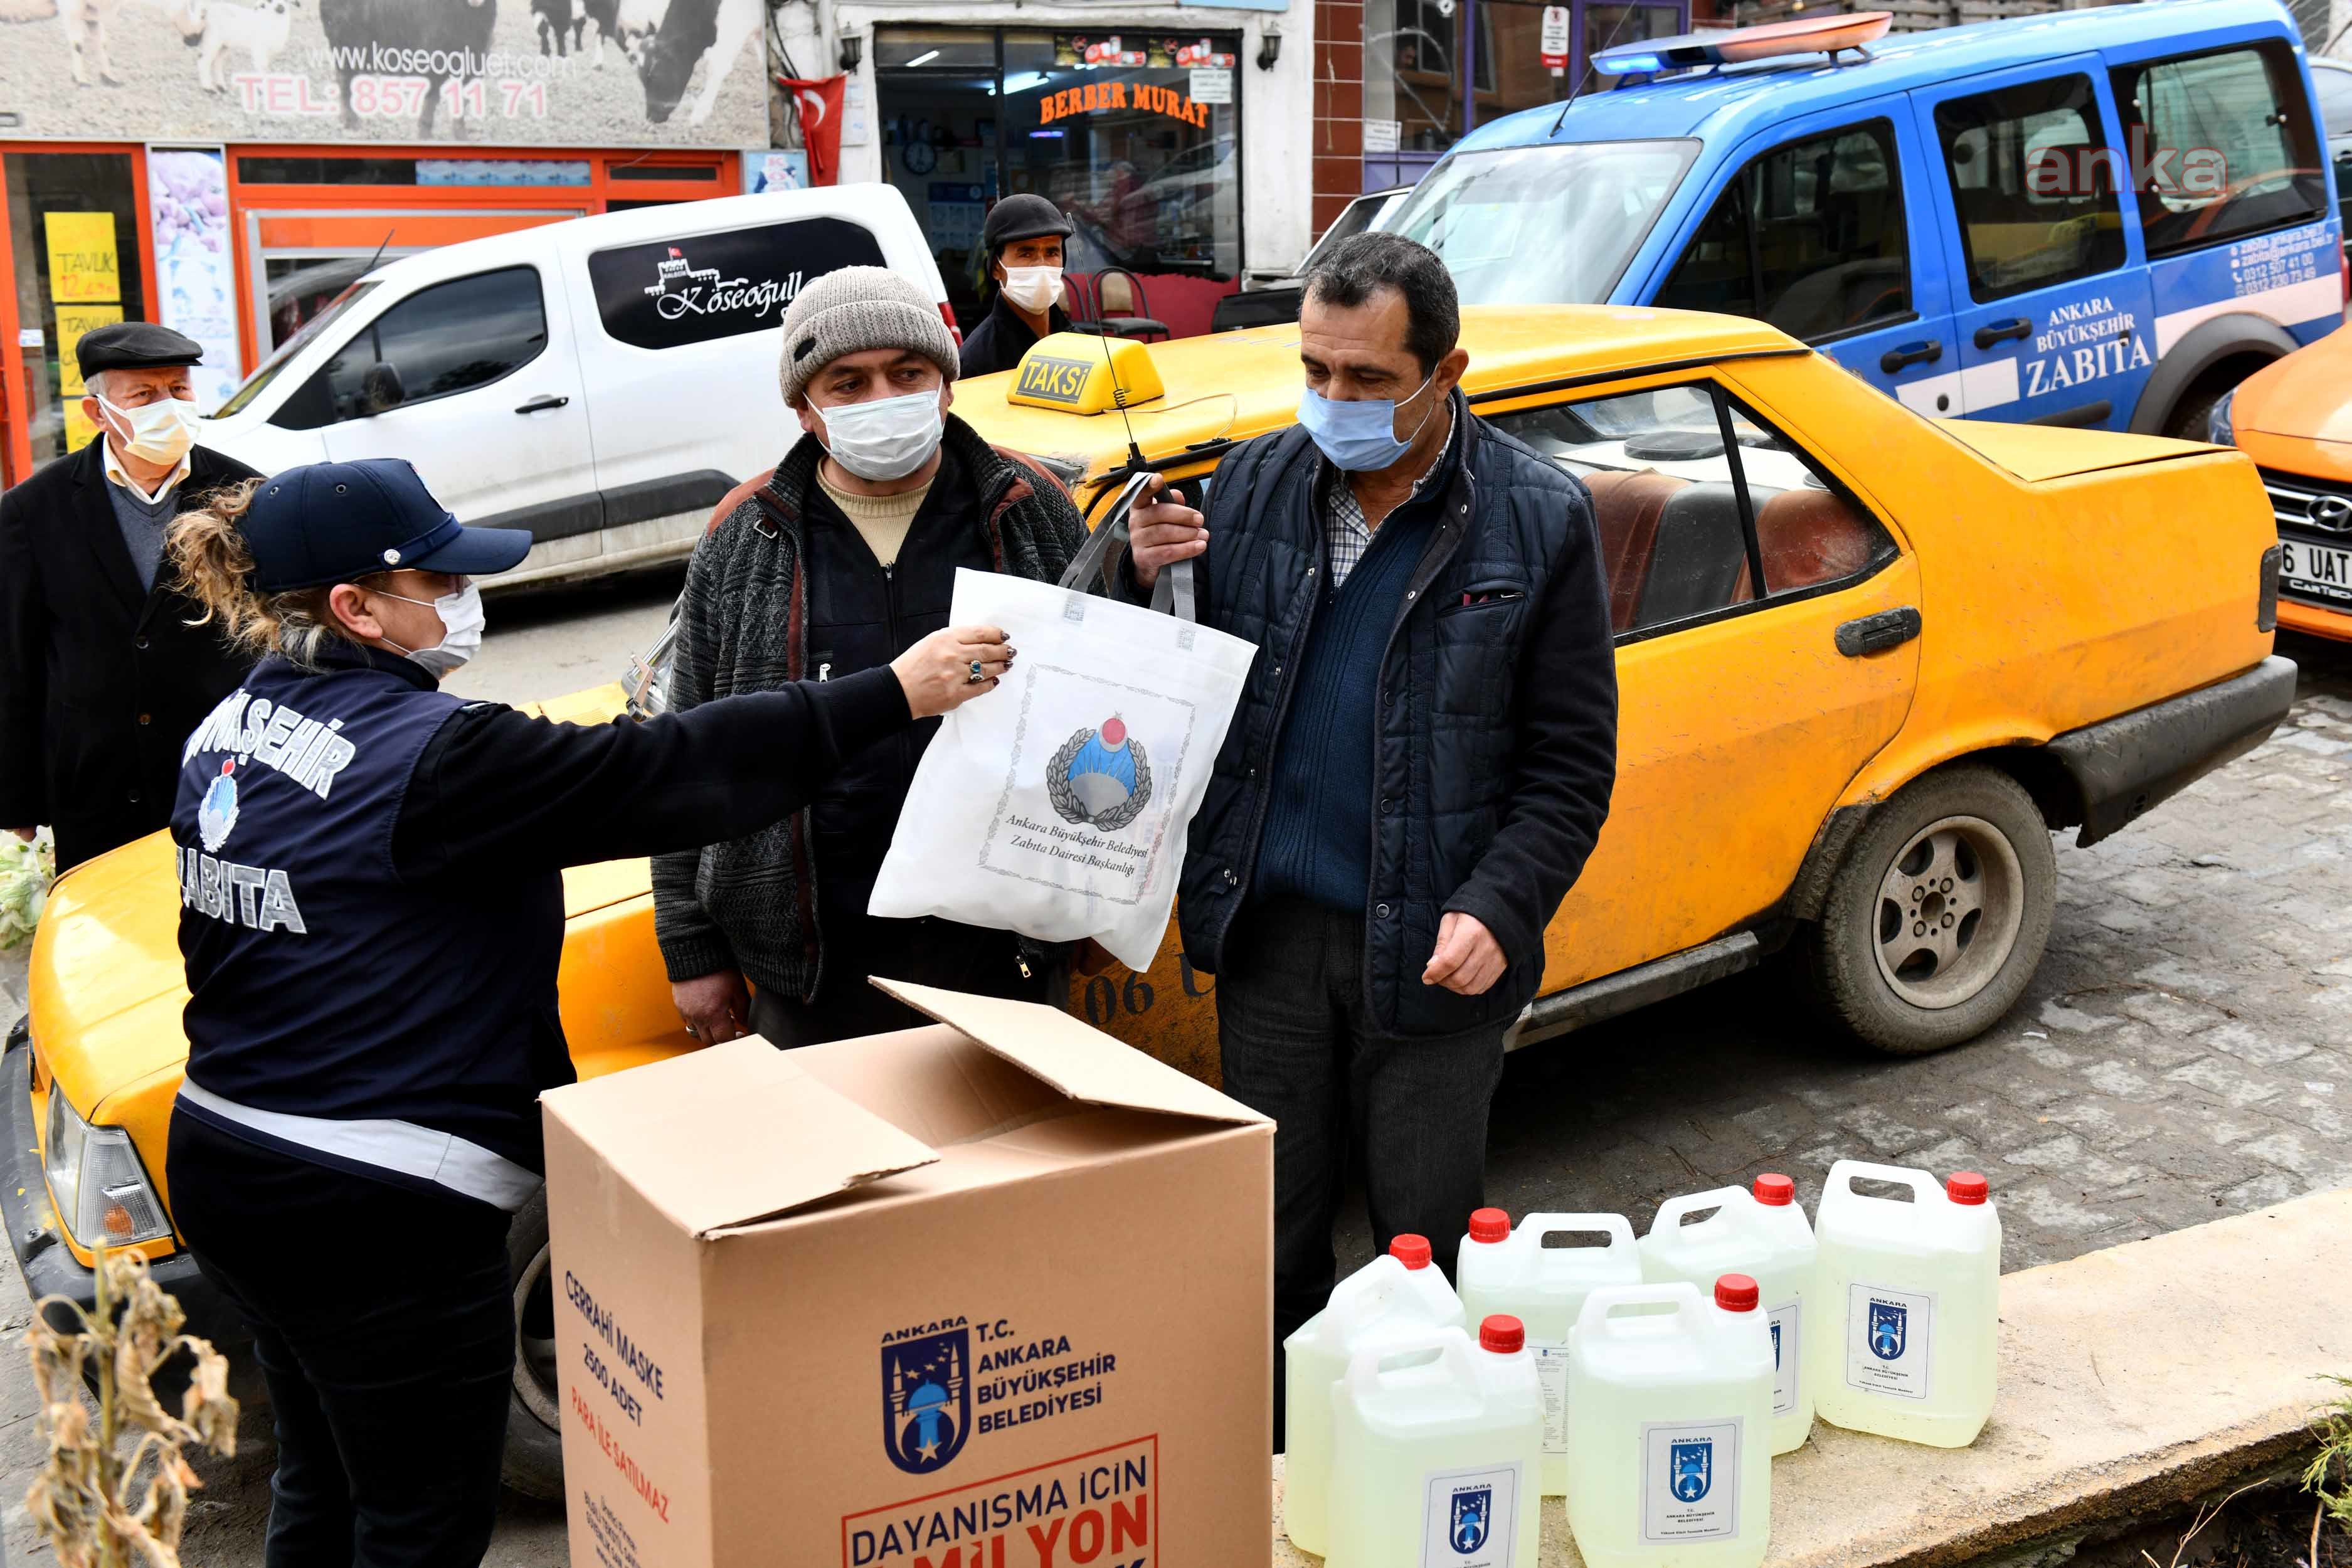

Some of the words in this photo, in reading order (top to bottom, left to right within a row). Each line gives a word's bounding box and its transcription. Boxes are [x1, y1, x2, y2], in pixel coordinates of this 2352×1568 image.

[305, 41, 576, 81] www.koseogluet.com
[235, 73, 341, 115] TEL:
[351, 75, 430, 119] 857
[439, 77, 486, 117] 11
[501, 79, 549, 119] 71
[1040, 82, 1127, 124] BERBER
[1133, 83, 1209, 129] MURAT
[55, 252, 115, 273] TAVUK
[2243, 265, 2267, 282] 0312
[657, 271, 805, 320] Köseoğull
[2048, 295, 2114, 327] ANKARA
[2036, 312, 2136, 353] BÜYÜKŞEHİR
[2025, 333, 2153, 398] ZABITA
[2281, 543, 2295, 573] 6
[2309, 547, 2349, 584] UAT
[1005, 814, 1047, 834] Ankara
[1049, 825, 1106, 849] Büyükşehir
[1106, 840, 1149, 859] Belediyesi
[1010, 834, 1047, 854] Zabıta
[1049, 845, 1086, 864] Dairesi
[1087, 855, 1135, 878] Başkanlığı
[1086, 972, 1154, 1025] 06
[1869, 1297, 1907, 1308] ANKARA
[566, 1270, 613, 1348] CERRAHİ
[617, 1326, 663, 1401] MASKE
[881, 1315, 968, 1343] ANKARA
[976, 1320, 1015, 1343] T.C.
[977, 1335, 1071, 1374] ANKARA
[584, 1343, 608, 1389] 2500
[611, 1377, 642, 1428] ADET
[977, 1353, 1116, 1405] BÜYÜKŞEHİR
[978, 1382, 1103, 1434] BELEDİYESİ
[572, 1385, 596, 1439] PARA
[613, 1441, 669, 1523] SATILMAZ
[1453, 1483, 1491, 1493] ANKARA
[913, 1493, 1148, 1568] YON
